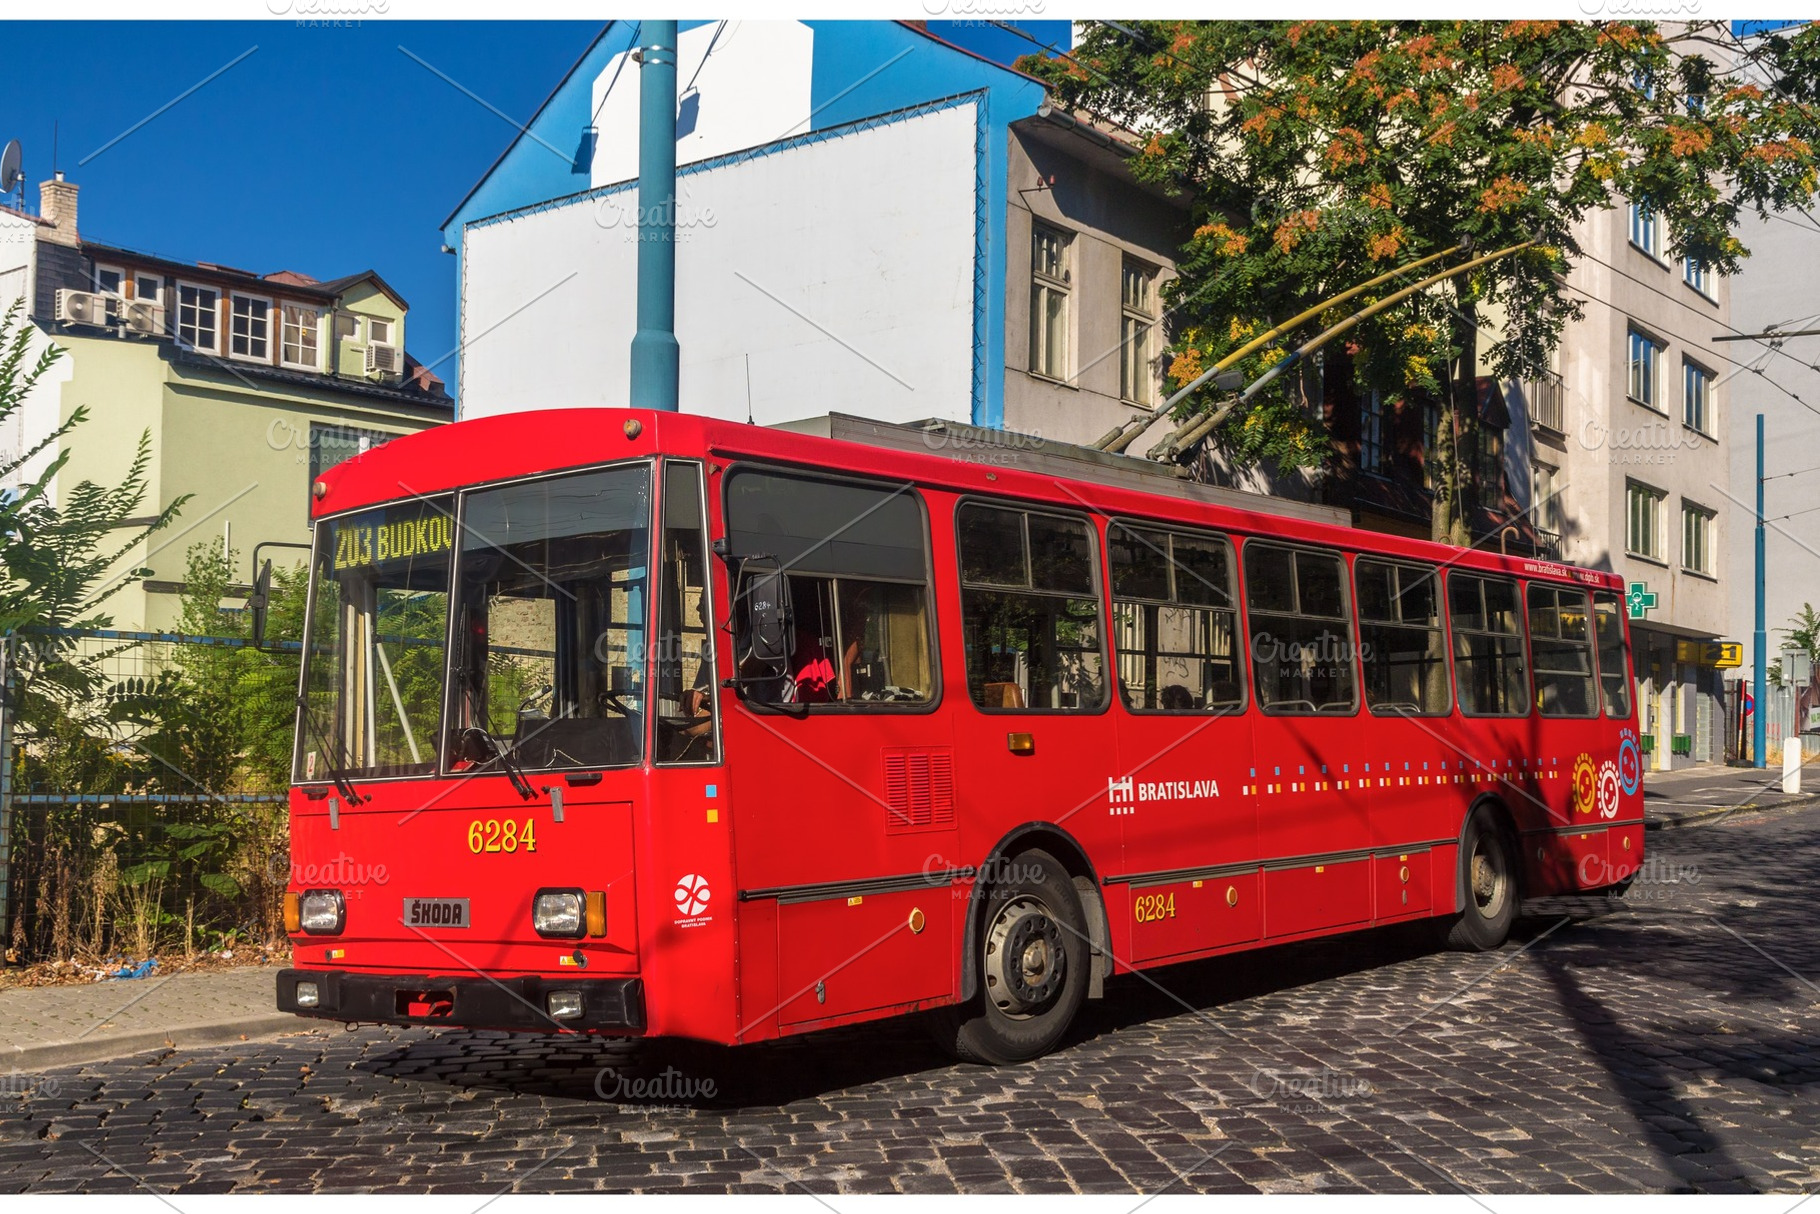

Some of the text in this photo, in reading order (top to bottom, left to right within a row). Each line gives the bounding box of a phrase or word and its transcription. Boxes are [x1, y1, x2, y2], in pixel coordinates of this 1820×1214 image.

[754, 601, 771, 611] 6284
[1138, 780, 1220, 801] BRATISLAVA
[468, 818, 536, 854] 6284
[411, 900, 462, 924] ŠKODA
[1135, 892, 1176, 923] 6284
